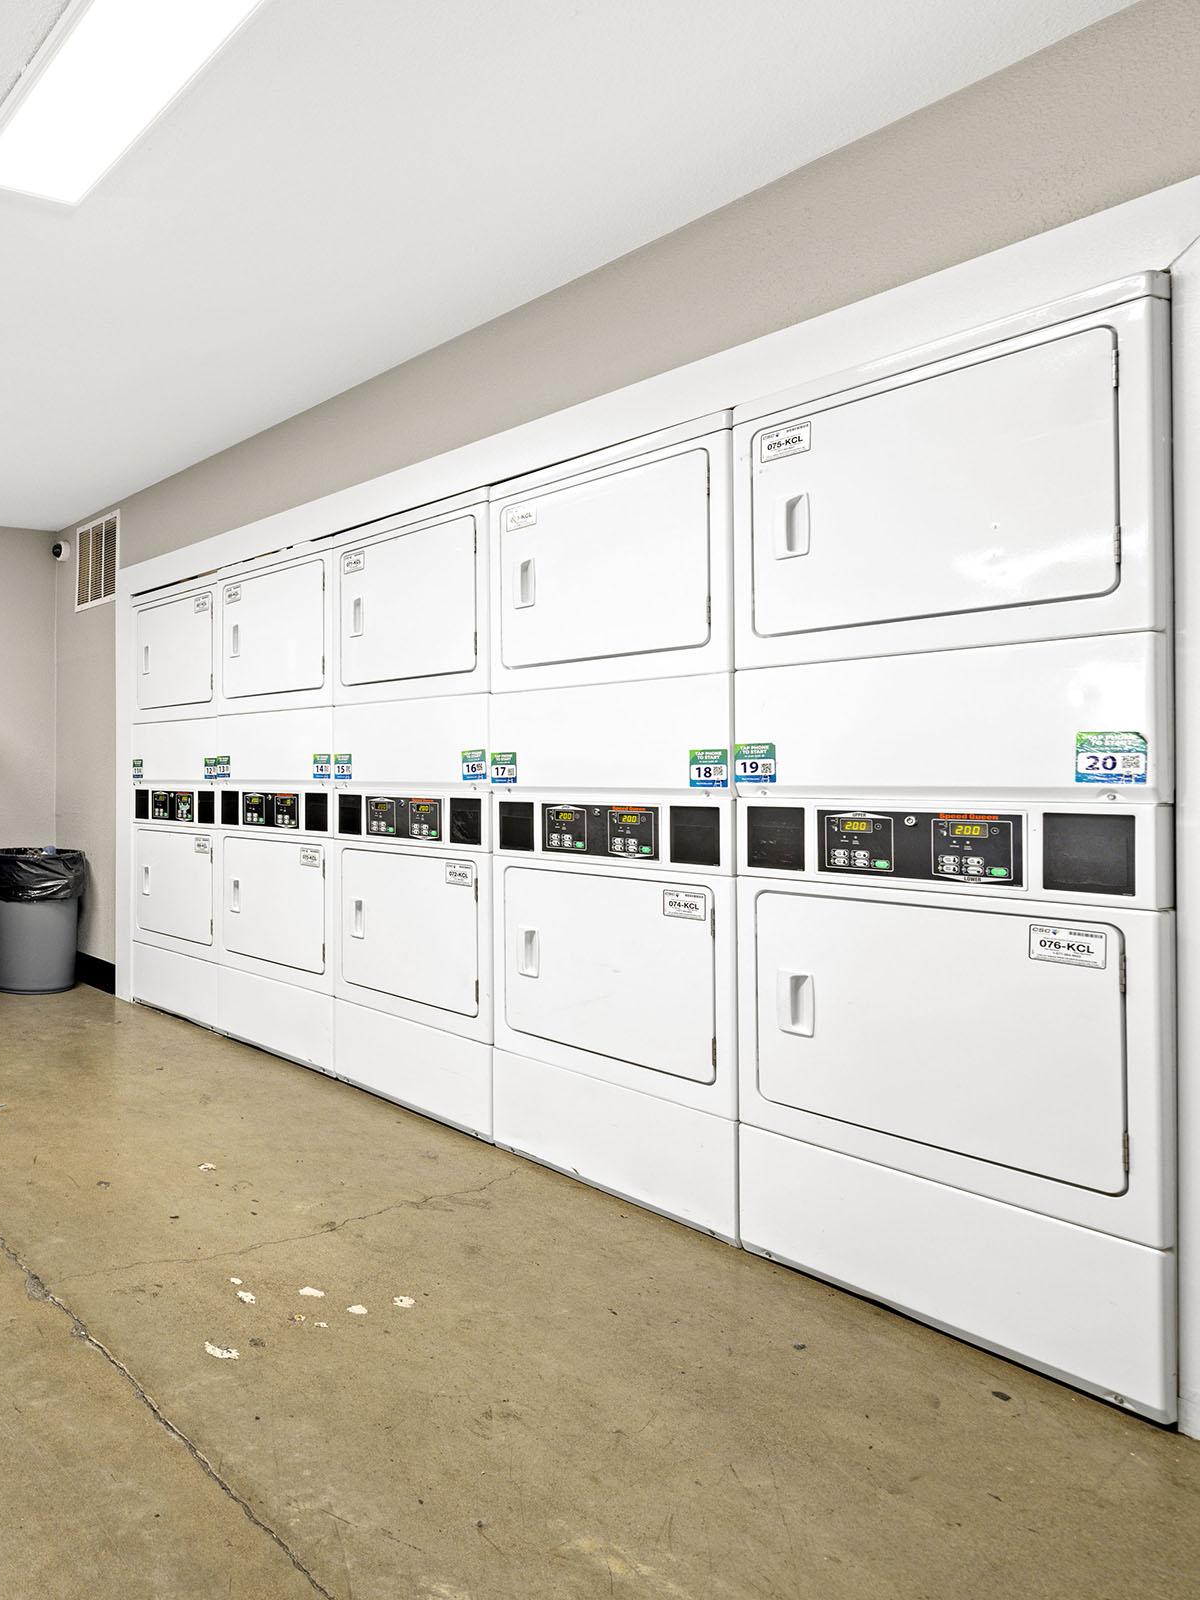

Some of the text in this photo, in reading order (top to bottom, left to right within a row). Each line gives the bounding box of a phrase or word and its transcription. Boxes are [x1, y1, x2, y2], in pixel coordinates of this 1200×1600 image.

[767, 436, 803, 450] 075-KCL
[741, 761, 759, 773] 19
[1085, 755, 1117, 770] 20
[315, 765, 323, 773] 14
[337, 765, 345, 773] 15
[466, 763, 477, 773] 16
[495, 767, 506, 776] 17
[695, 766, 712, 778] 18
[559, 812, 571, 820] 200
[939, 812, 967, 820] Speed
[845, 822, 867, 830] 200
[954, 825, 980, 835] 200
[668, 900, 700, 910] 074-KCL
[1039, 939, 1095, 954] 076-KCL
